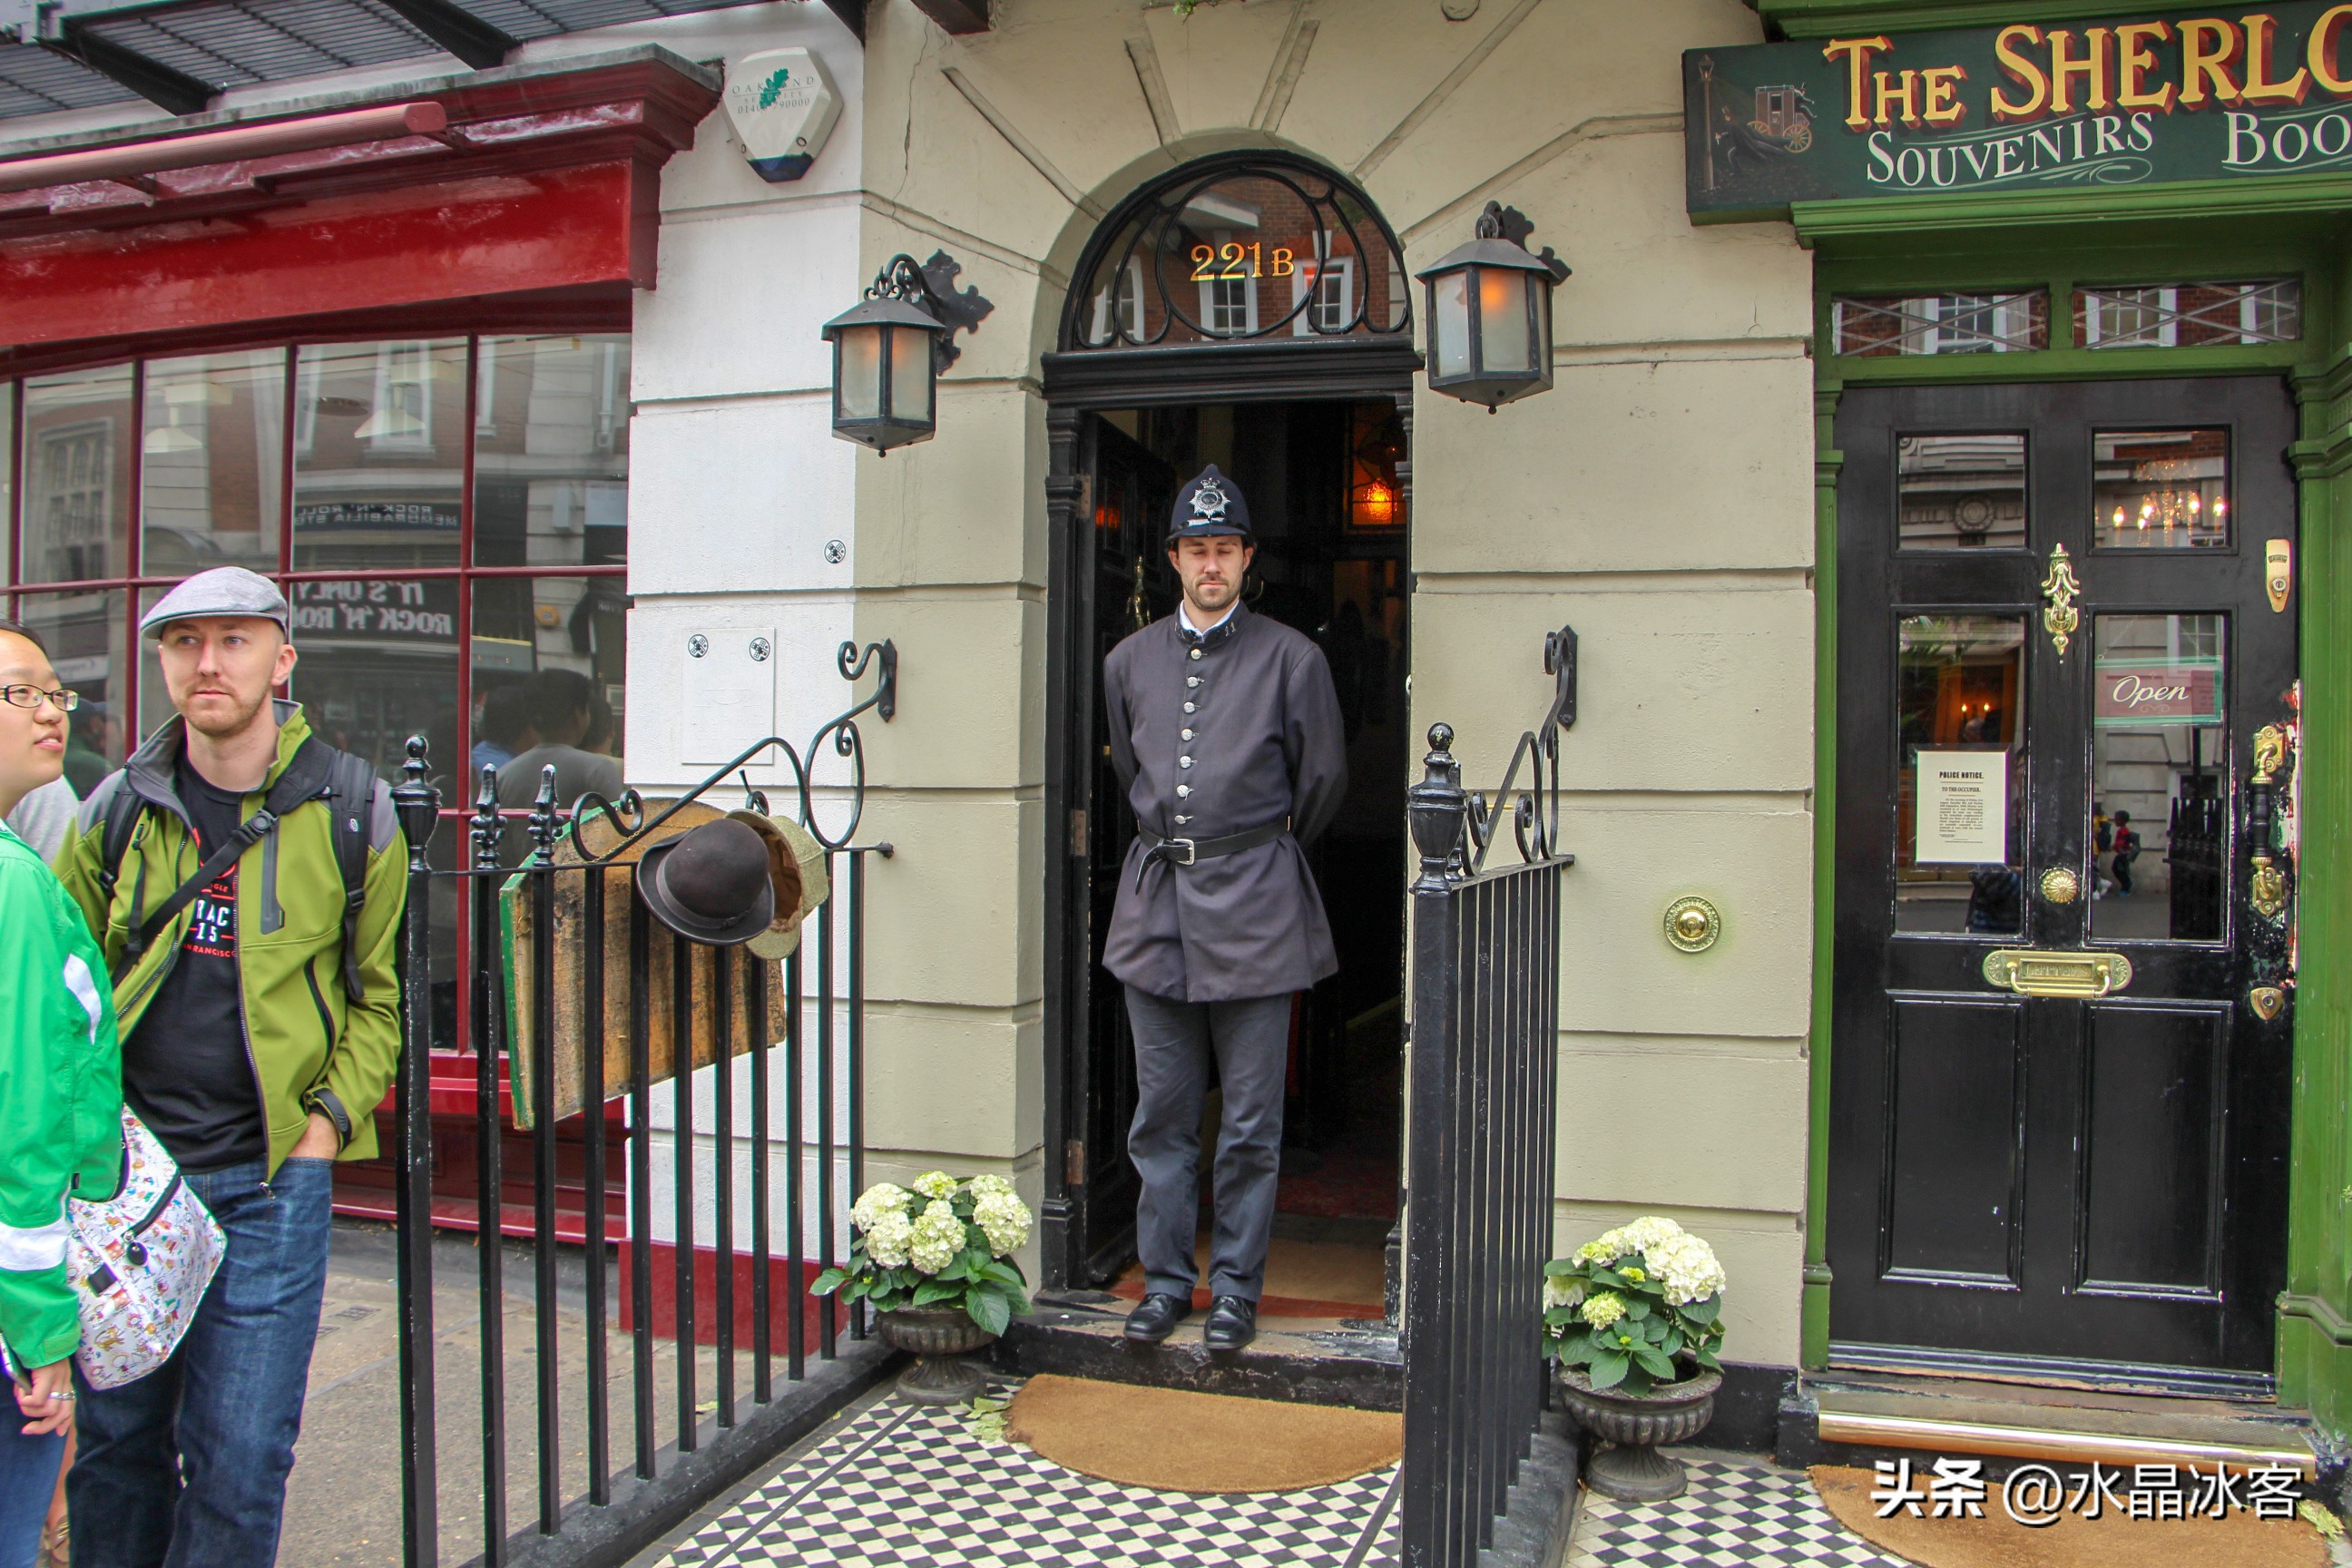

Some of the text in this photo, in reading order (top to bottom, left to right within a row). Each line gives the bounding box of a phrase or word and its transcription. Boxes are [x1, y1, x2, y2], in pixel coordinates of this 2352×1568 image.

[1866, 111, 2352, 188] SOUVENIRS BOO
[2112, 675, 2190, 709] Open
[211, 883, 229, 893] GLE
[192, 945, 236, 958] RANCISCO
